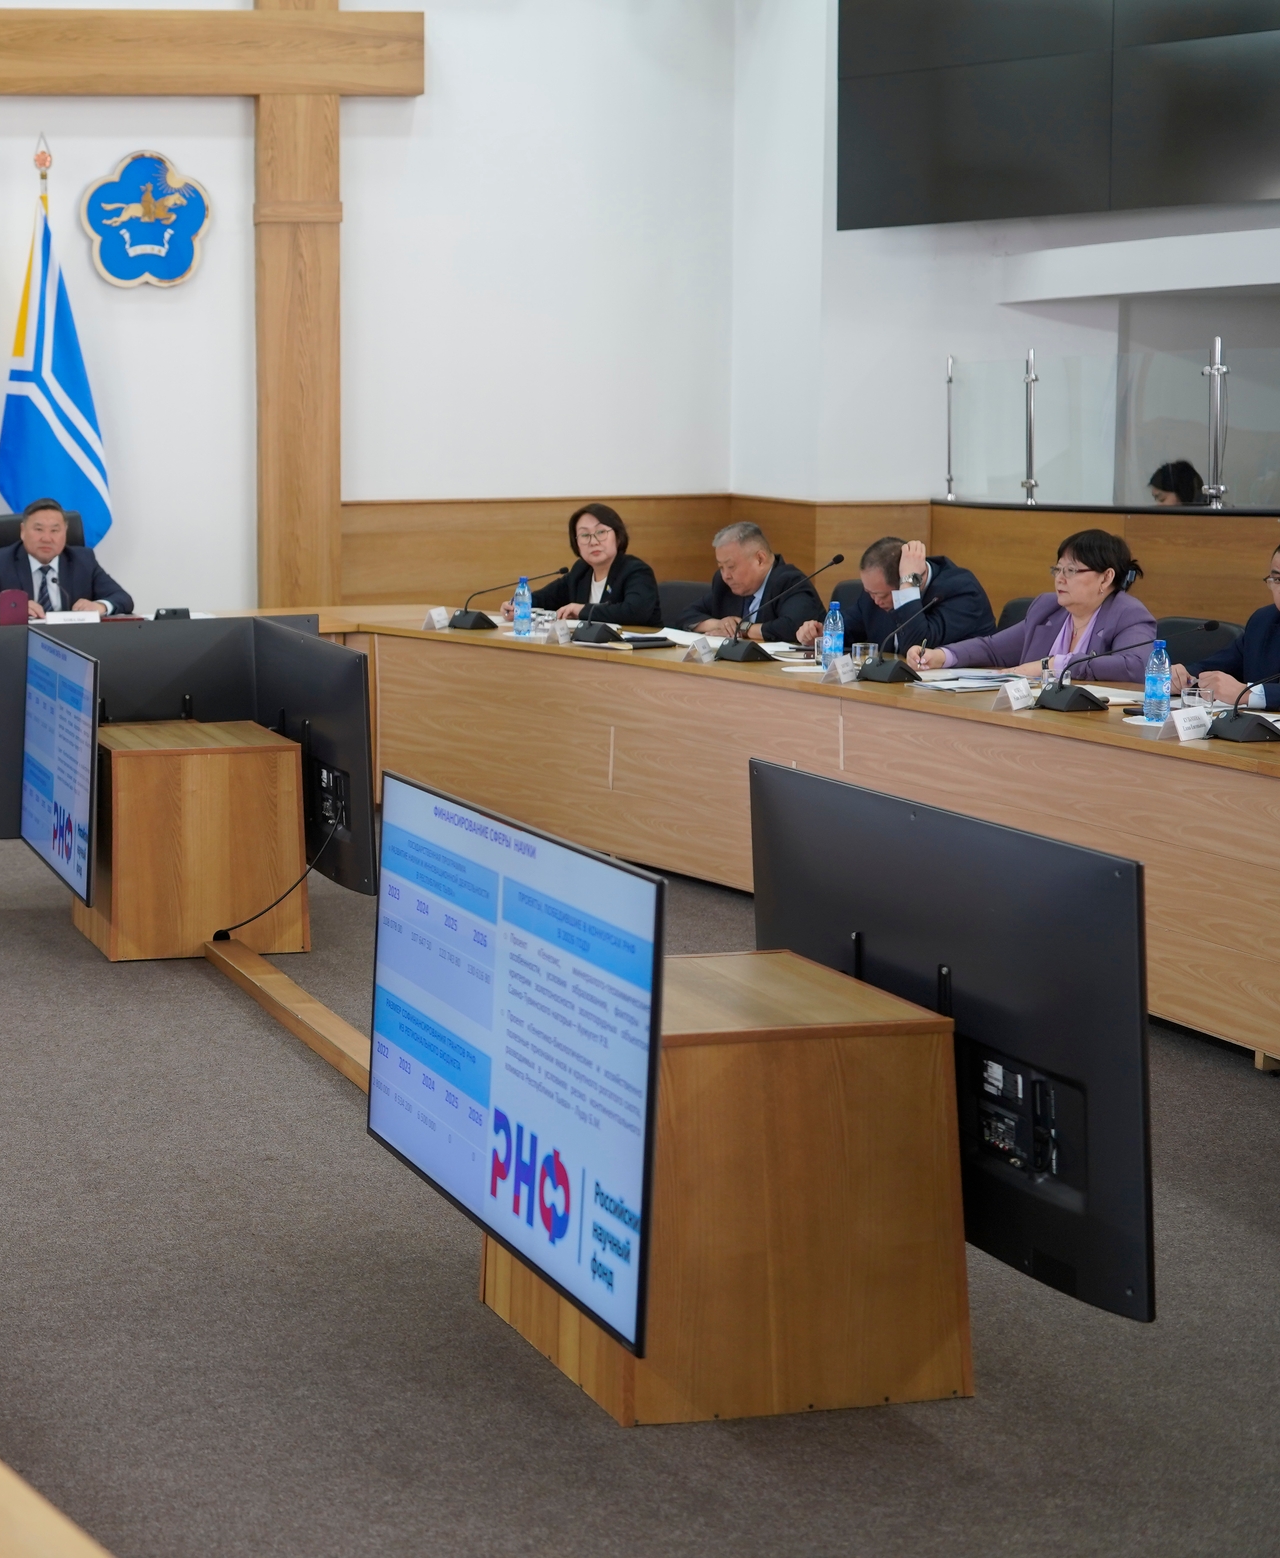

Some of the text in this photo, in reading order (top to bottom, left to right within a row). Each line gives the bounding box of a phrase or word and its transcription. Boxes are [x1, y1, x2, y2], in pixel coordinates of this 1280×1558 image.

[433, 805, 537, 860] ФИНАНСИРОВАНИЕ СФЕРЫ НАУКИ
[388, 884, 487, 948] 2023 2024 2025 2026
[386, 998, 476, 1065] РАЗМЕР СОФИНАНСИРОВАНИЯ ГРАНТОВ РНФ
[405, 1026, 439, 1056] РЕГИОНАЛЬНОГО
[377, 1041, 483, 1126] 2022 2023 2024 2025 2026
[490, 1107, 571, 1246] РНФ
[594, 1180, 641, 1237] Российски
[592, 1220, 631, 1265] научный
[590, 1251, 614, 1293] фонд
